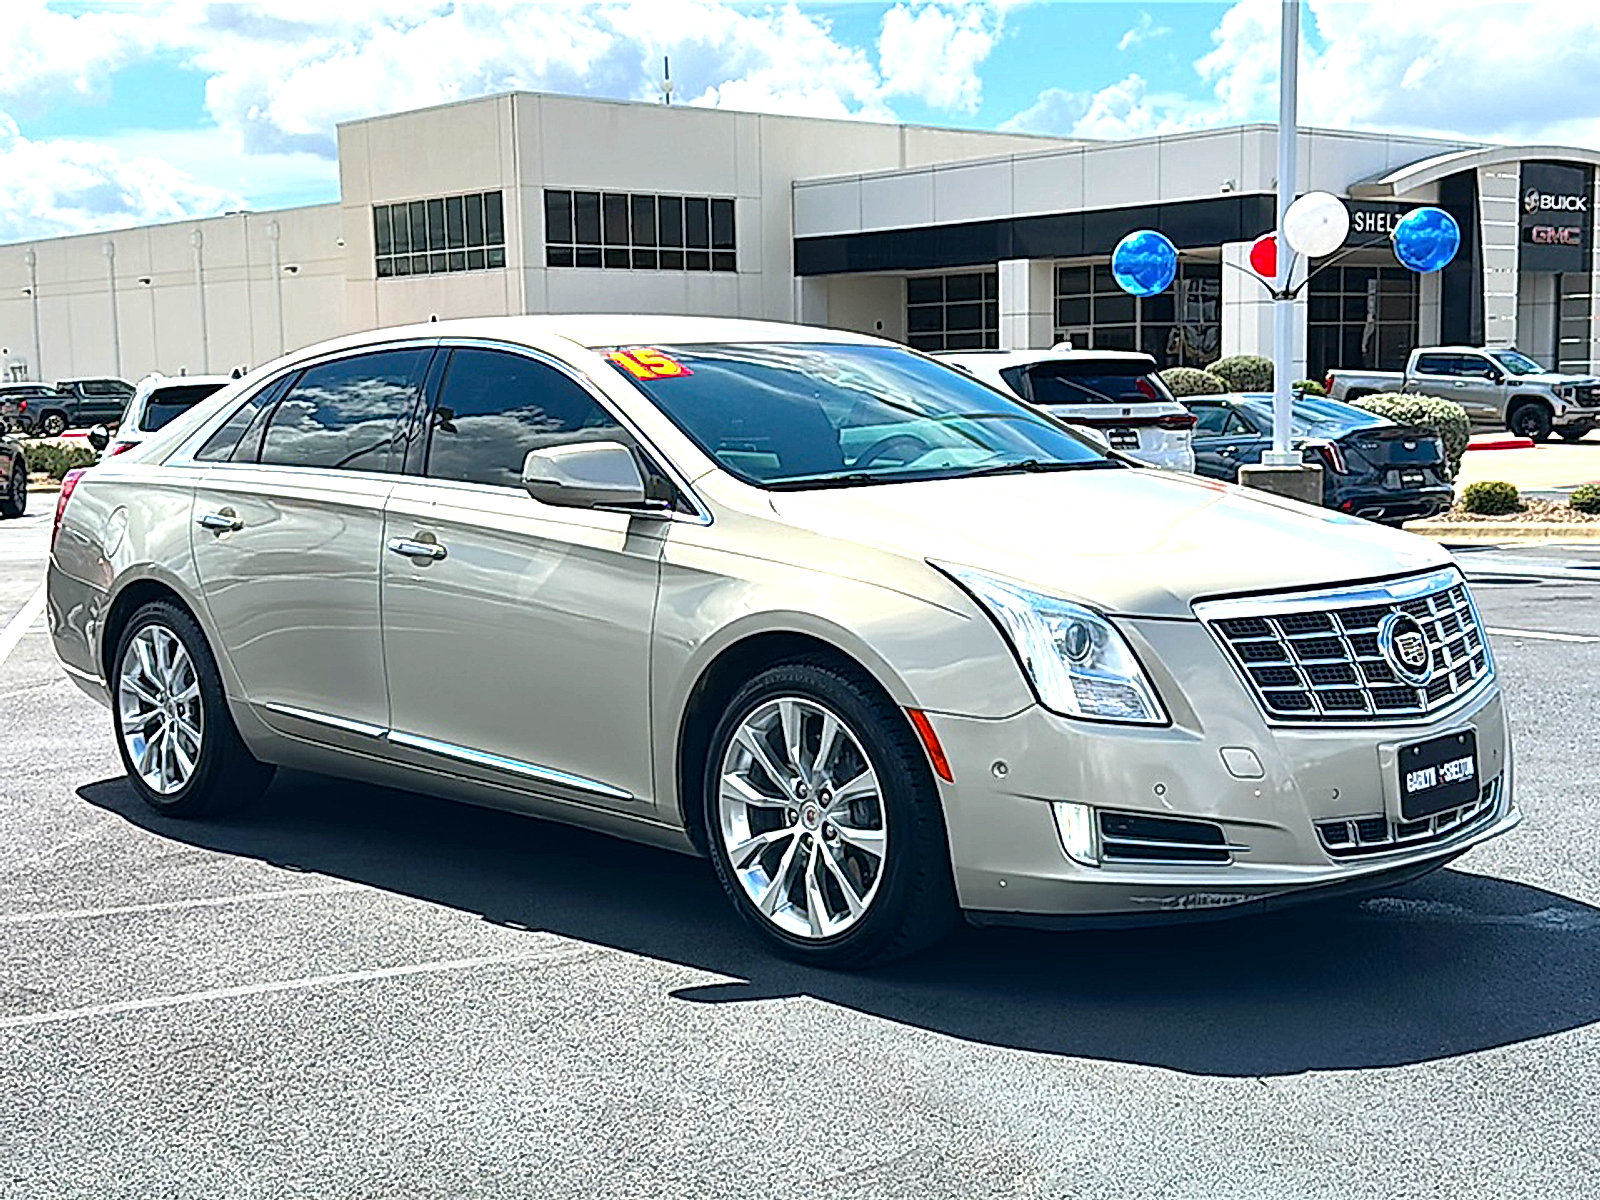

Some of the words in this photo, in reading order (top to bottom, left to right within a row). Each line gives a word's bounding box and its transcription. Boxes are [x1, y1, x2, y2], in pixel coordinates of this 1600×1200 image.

[1540, 195, 1588, 211] BUICK
[1355, 211, 1402, 232] SHEL
[1532, 226, 1581, 245] GMC
[609, 349, 682, 378] 15
